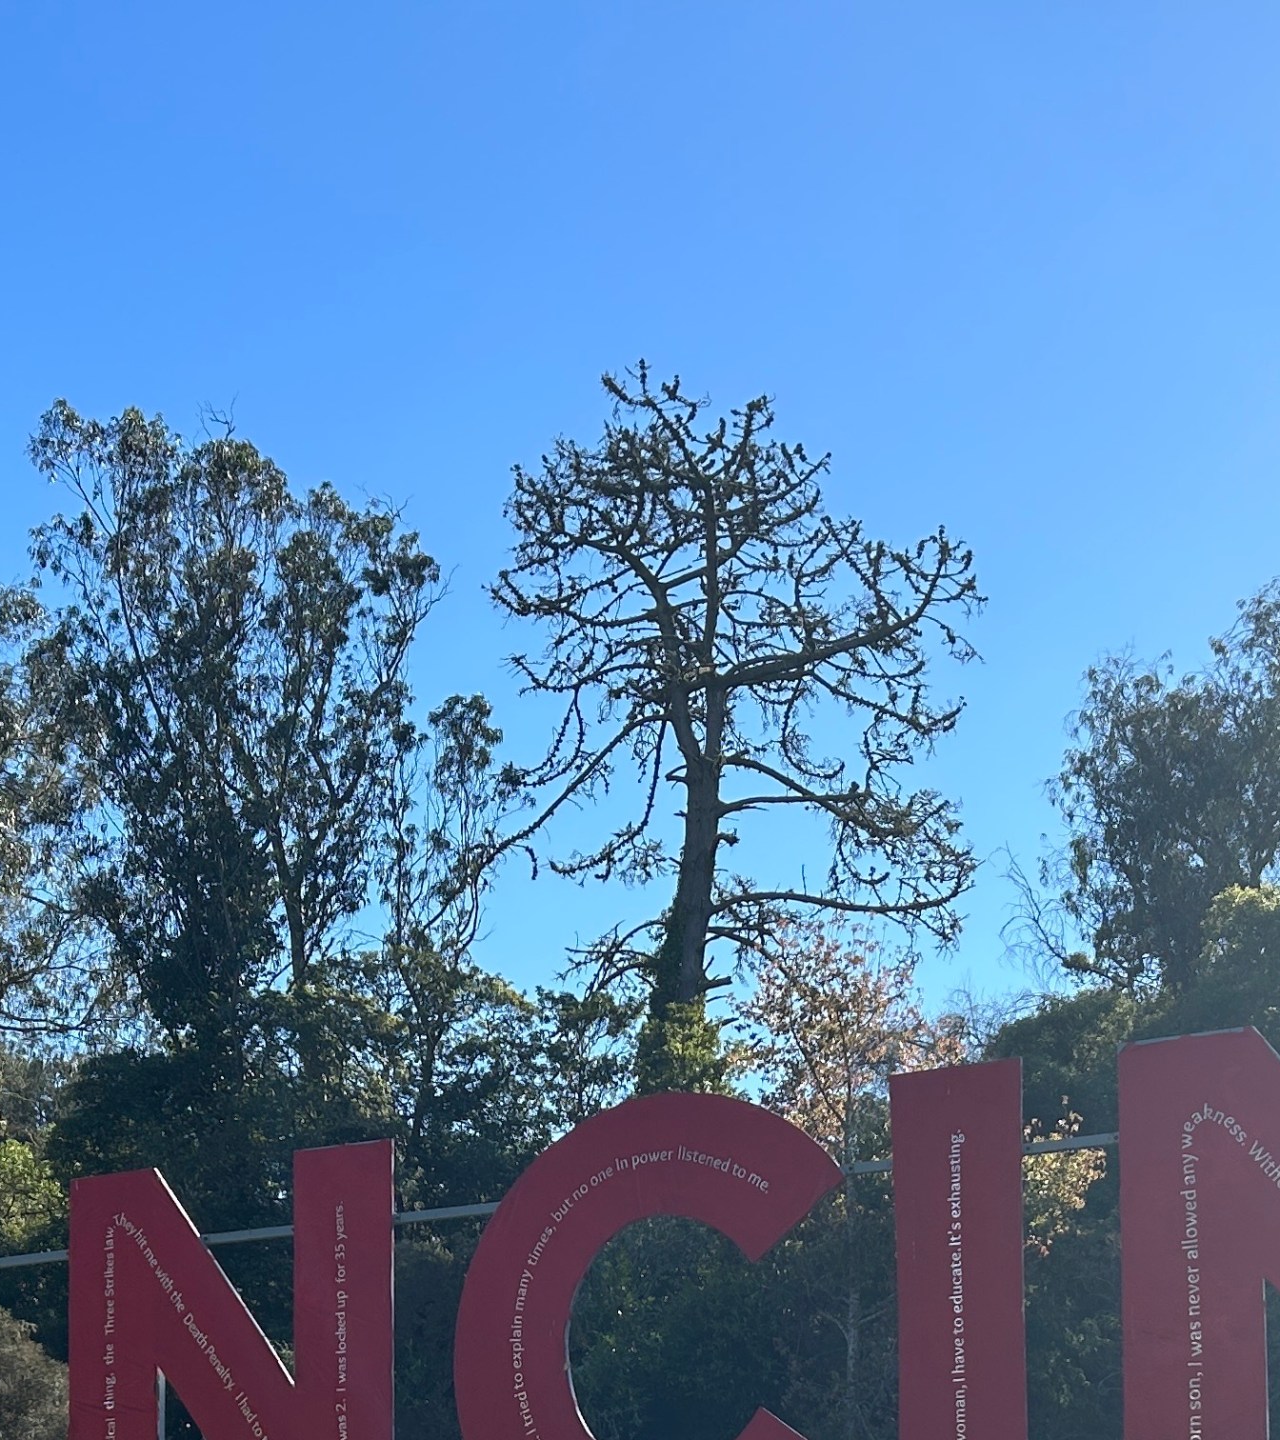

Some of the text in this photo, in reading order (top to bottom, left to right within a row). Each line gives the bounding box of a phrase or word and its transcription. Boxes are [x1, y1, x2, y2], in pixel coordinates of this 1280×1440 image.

[1180, 1102, 1247, 1150] weakness.
[614, 1157, 629, 1171] in
[630, 1150, 674, 1171] power
[677, 1144, 732, 1173] listened
[731, 1162, 747, 1179] to
[1181, 1153, 1199, 1186] any
[589, 1166, 614, 1187] one
[746, 1172, 769, 1194] me.
[946, 1128, 966, 1219] exhausting.
[571, 1183, 589, 1201] no
[335, 1200, 348, 1241] years.
[549, 1197, 574, 1223] but
[946, 1221, 962, 1246] It's
[1179, 1188, 1199, 1260] allowed
[132, 1227, 148, 1250] hit
[526, 1225, 557, 1266] times,
[142, 1246, 158, 1268] me
[333, 1243, 346, 1261] 35
[154, 1265, 174, 1294] with
[334, 1263, 346, 1284] for
[948, 1247, 964, 1314] educate.
[169, 1290, 185, 1313] the
[335, 1290, 349, 1309] up
[514, 1268, 534, 1312] many
[1186, 1265, 1201, 1316] never
[182, 1311, 208, 1349] Death
[952, 1317, 964, 1335] to
[1189, 1320, 1203, 1357] was
[508, 1314, 525, 1369] explain
[950, 1337, 965, 1374] have
[337, 1356, 347, 1385] was
[513, 1372, 524, 1390] to
[234, 1391, 245, 1401] I
[1188, 1371, 1204, 1410] son,
[237, 1395, 258, 1424] had
[334, 1397, 347, 1412] 2.
[513, 1390, 534, 1427] tried
[251, 1420, 263, 1437] to
[525, 1427, 537, 1436] I
